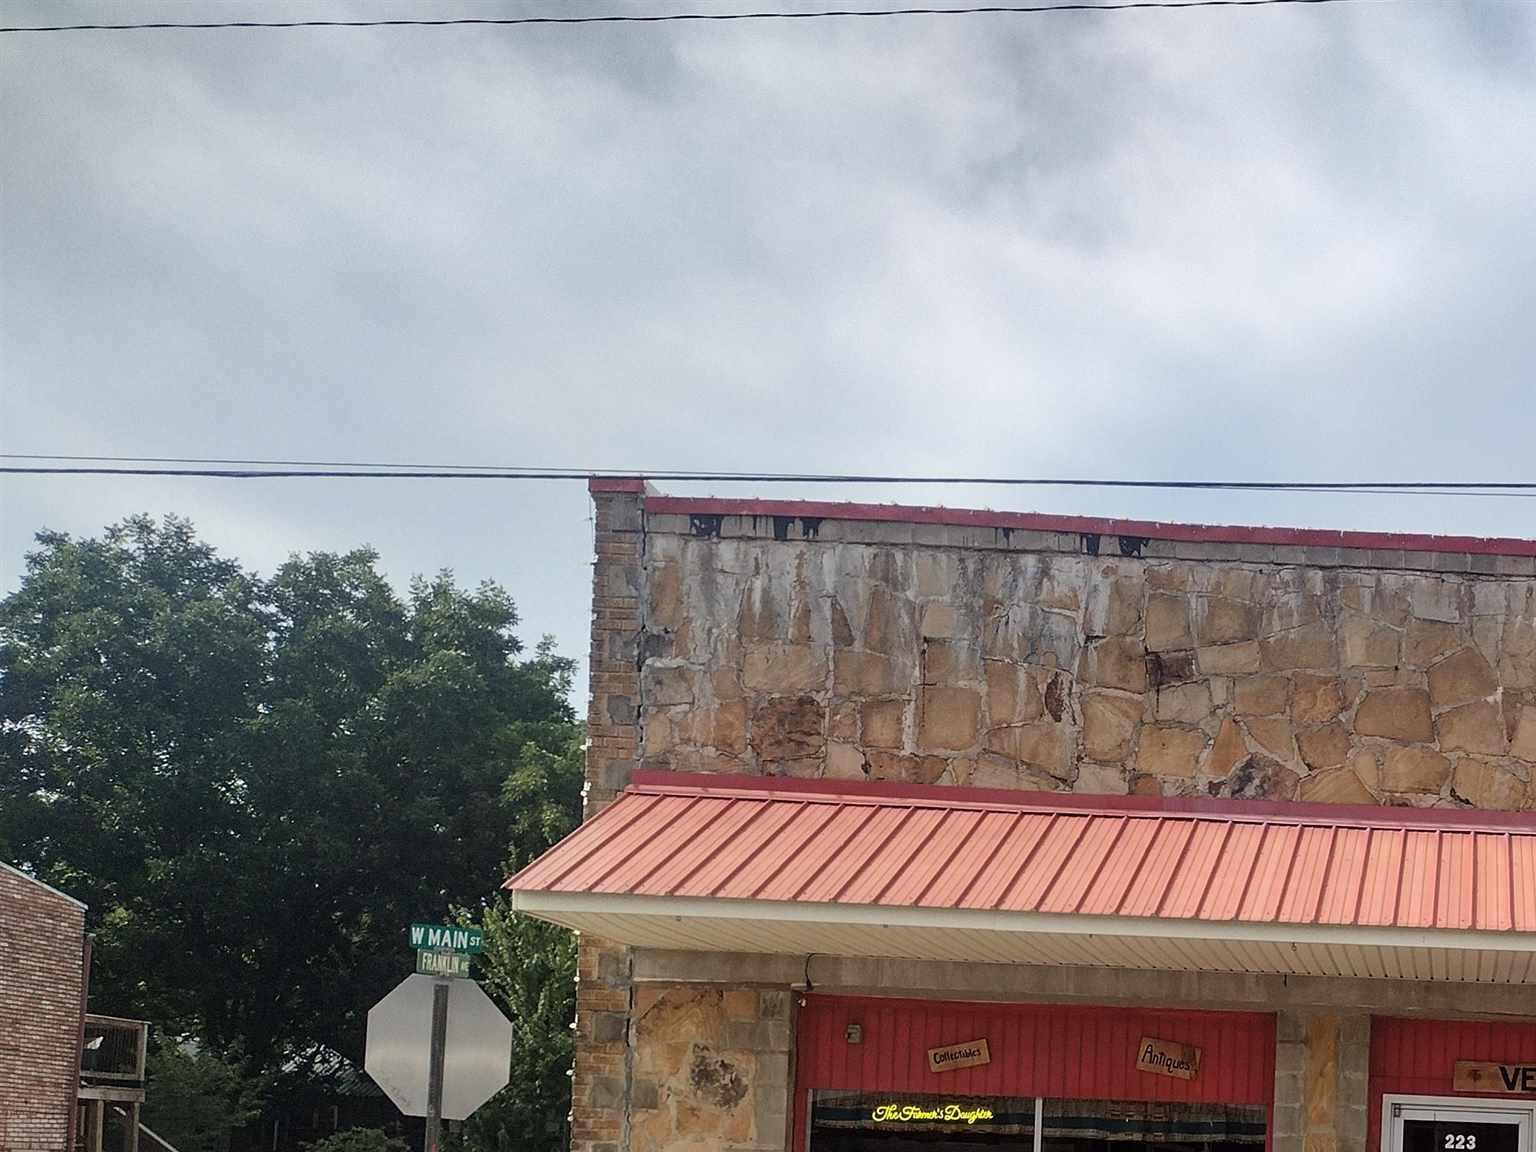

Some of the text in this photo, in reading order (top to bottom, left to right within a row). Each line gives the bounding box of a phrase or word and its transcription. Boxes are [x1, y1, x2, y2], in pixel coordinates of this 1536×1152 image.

[412, 927, 480, 949] W MAIN ST
[422, 952, 460, 974] FRANKLIN
[933, 1048, 981, 1065] Collectibles
[1141, 1043, 1191, 1074] Antiques
[872, 1104, 994, 1124] The Farmer's Daughter
[1444, 1134, 1476, 1150] 223
